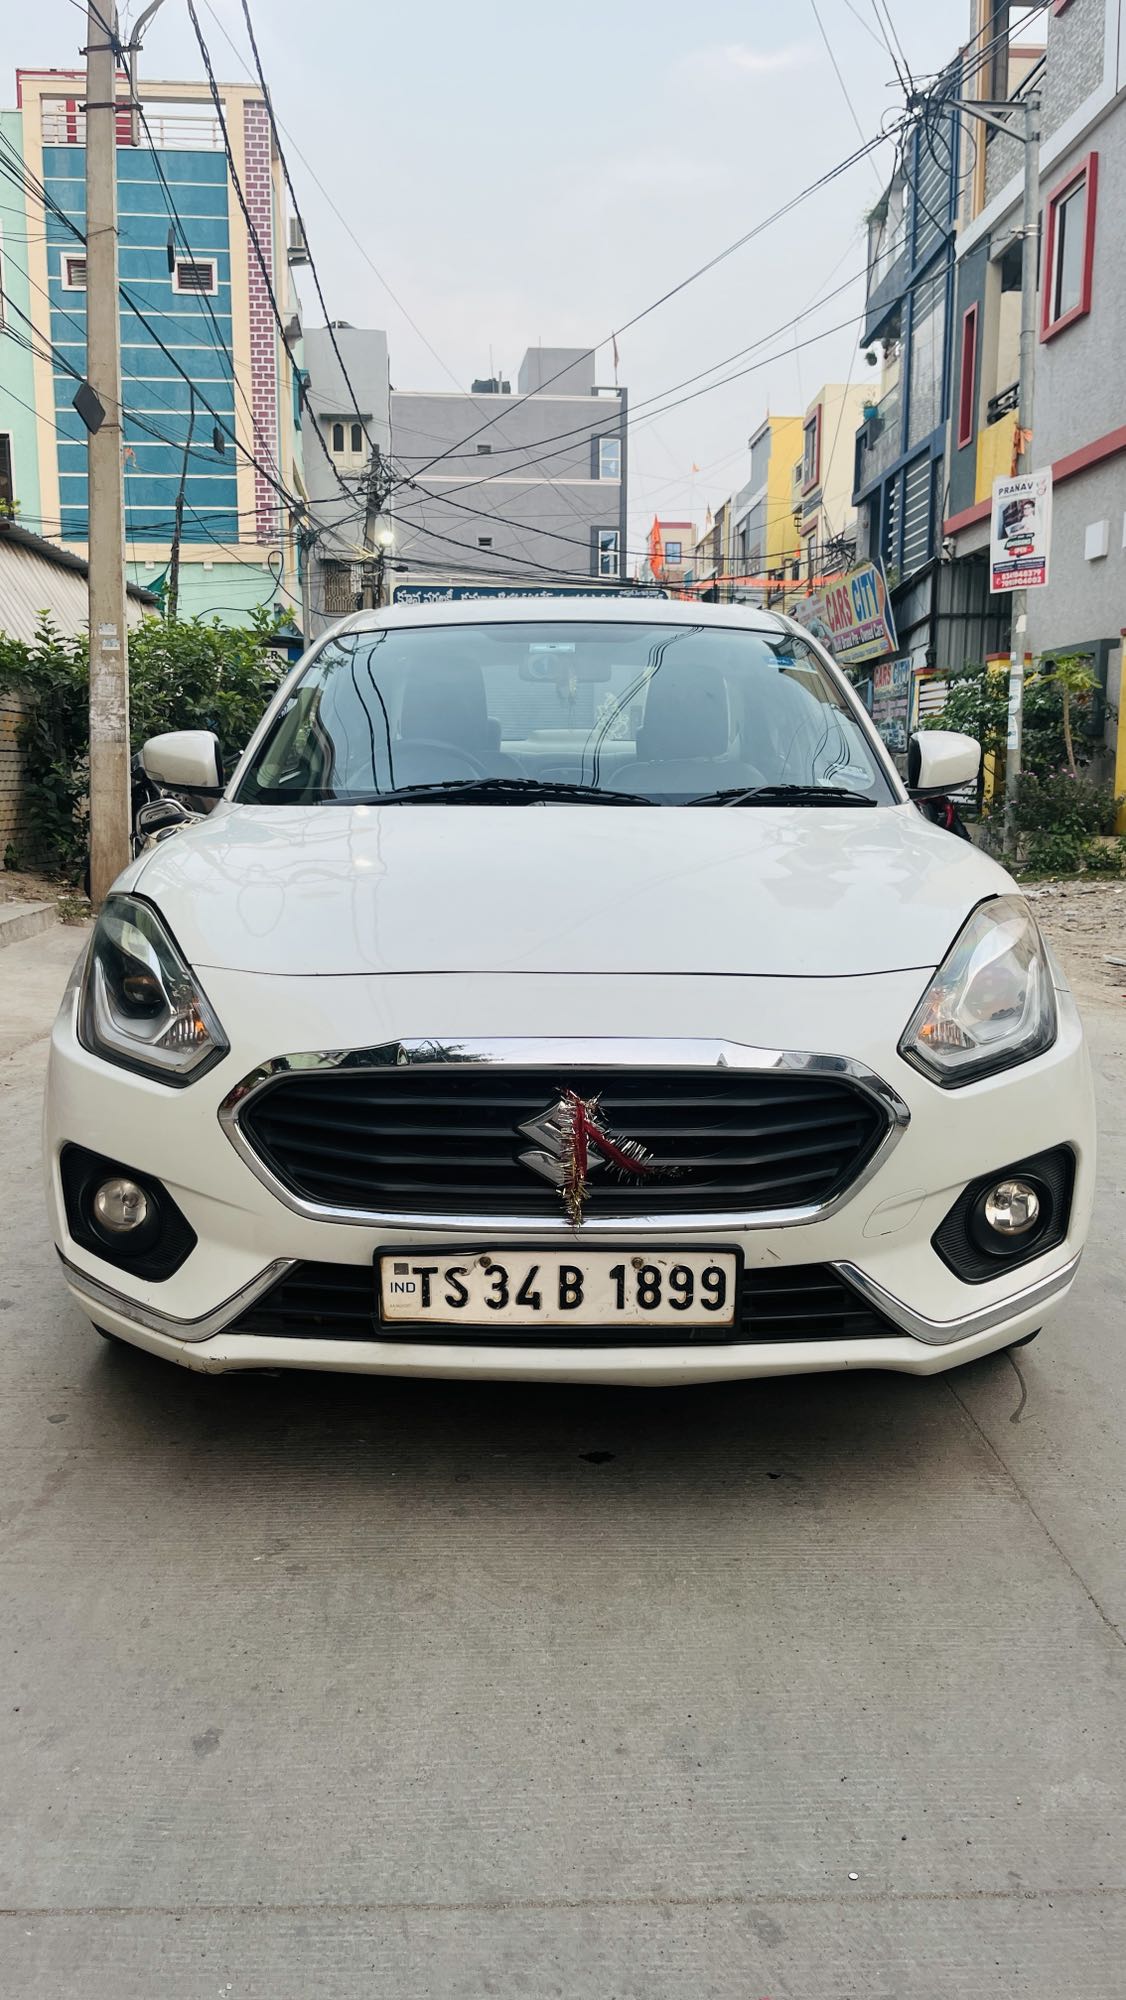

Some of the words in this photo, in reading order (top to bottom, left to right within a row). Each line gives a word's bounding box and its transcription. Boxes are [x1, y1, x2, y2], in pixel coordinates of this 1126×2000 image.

[998, 481, 1034, 496] PRANAV
[825, 585, 853, 632] CARS
[851, 569, 880, 622] CITY
[875, 663, 892, 688] CARS
[892, 659, 910, 684] CITY
[390, 1281, 416, 1293] IND
[412, 1266, 469, 1308] TS
[484, 1264, 542, 1311] 34
[558, 1264, 585, 1311] B
[609, 1264, 727, 1311] 1899
